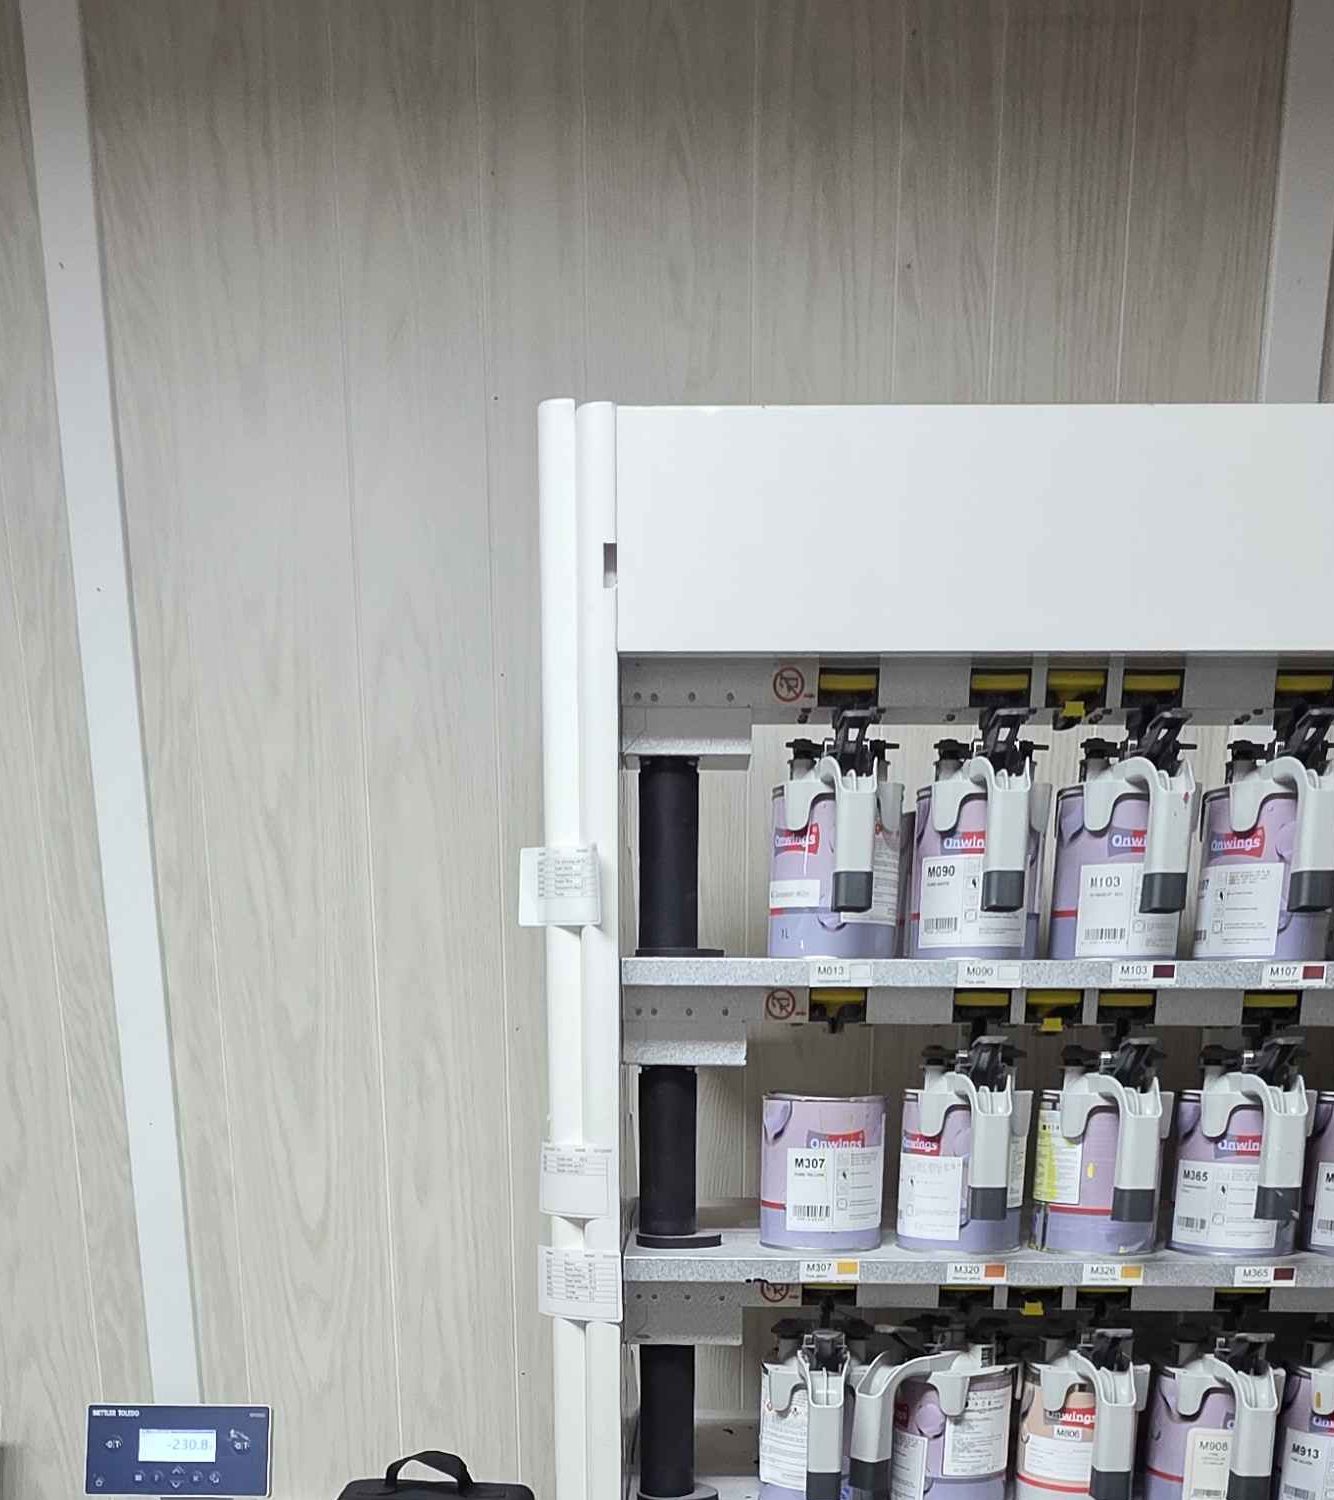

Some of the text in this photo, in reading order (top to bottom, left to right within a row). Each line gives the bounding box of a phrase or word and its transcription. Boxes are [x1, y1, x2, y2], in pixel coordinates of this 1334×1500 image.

[943, 837, 986, 849] Onwin
[927, 864, 955, 879] M090
[816, 965, 845, 976] M013
[966, 966, 994, 977] M090
[1120, 965, 1148, 977] M103
[1269, 966, 1298, 977] M107
[1217, 1139, 1261, 1152] Onwin
[794, 1157, 825, 1169] M307
[1182, 1169, 1209, 1183] M365
[805, 1263, 833, 1273] M307
[953, 1265, 980, 1275] M320
[1242, 1268, 1269, 1278] M365
[117, 1409, 139, 1417] TOLEDO
[1198, 1440, 1229, 1451] M908
[1291, 1443, 1320, 1460] M913
